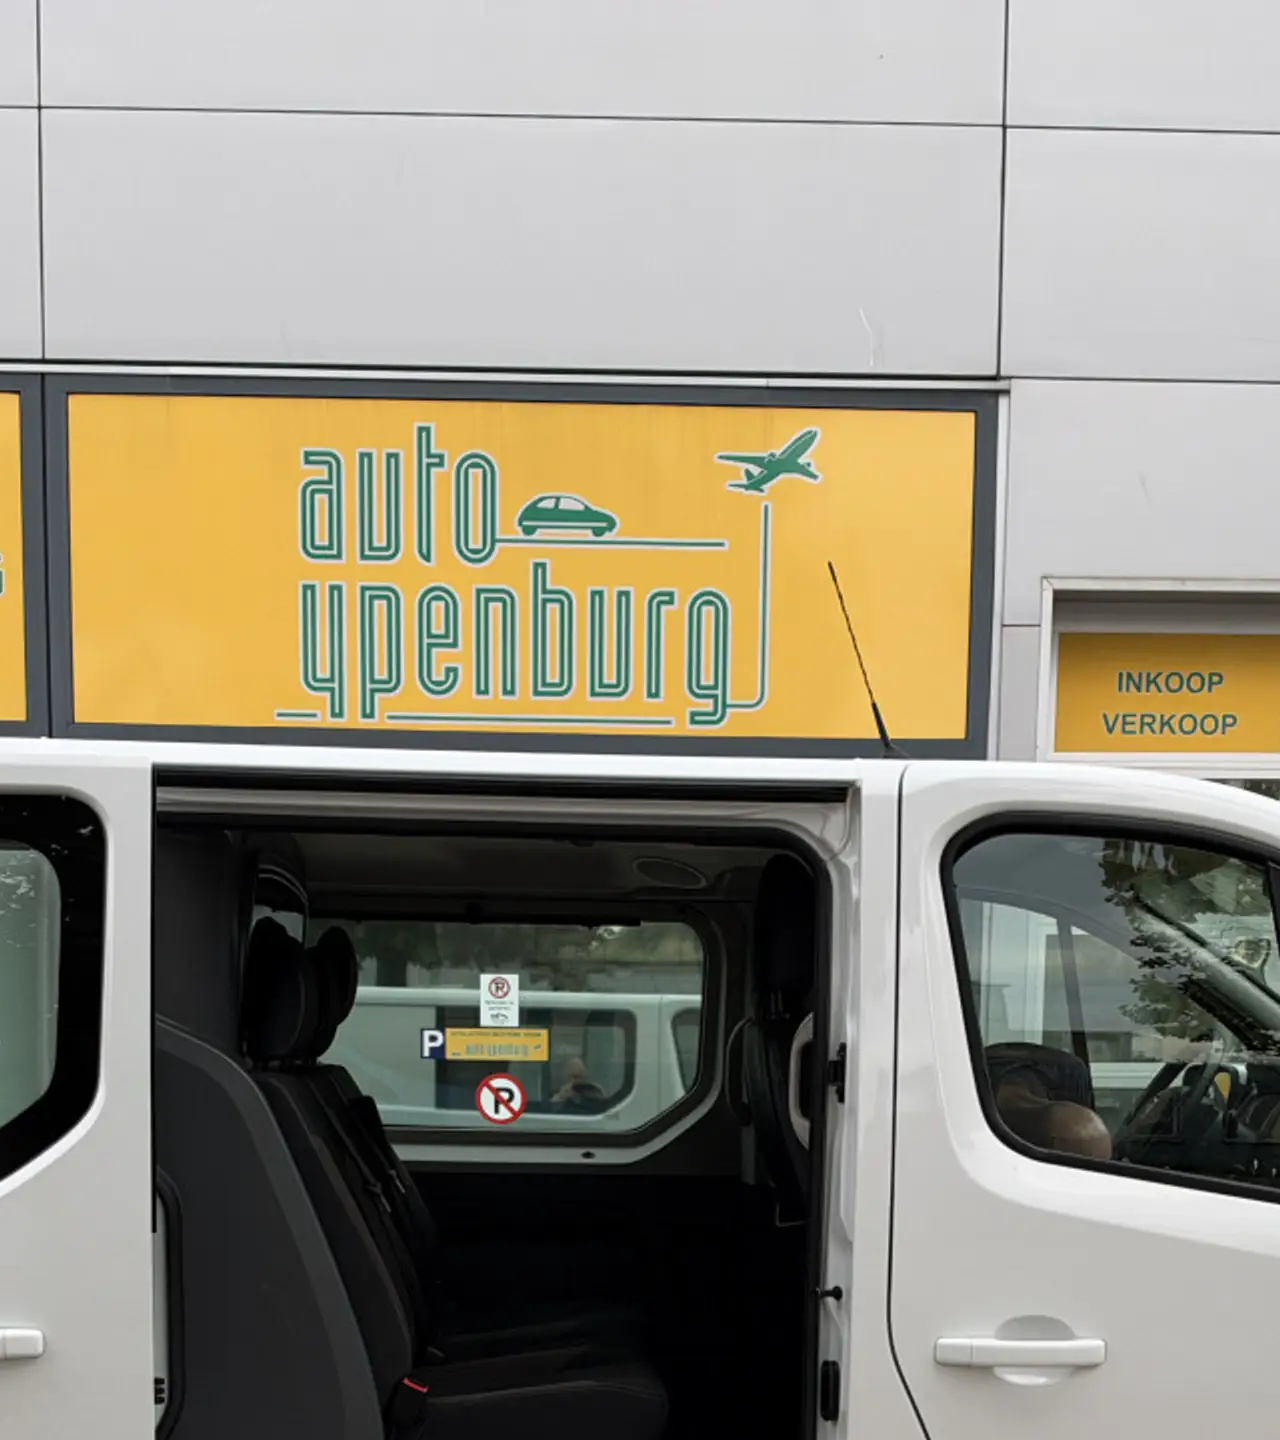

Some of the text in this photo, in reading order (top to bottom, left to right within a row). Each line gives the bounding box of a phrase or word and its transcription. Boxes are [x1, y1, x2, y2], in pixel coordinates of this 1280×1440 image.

[298, 424, 499, 565] auto
[299, 560, 730, 726] ypenburg
[1117, 671, 1224, 693] INKOOP
[1102, 712, 1238, 735] VERKOOP
